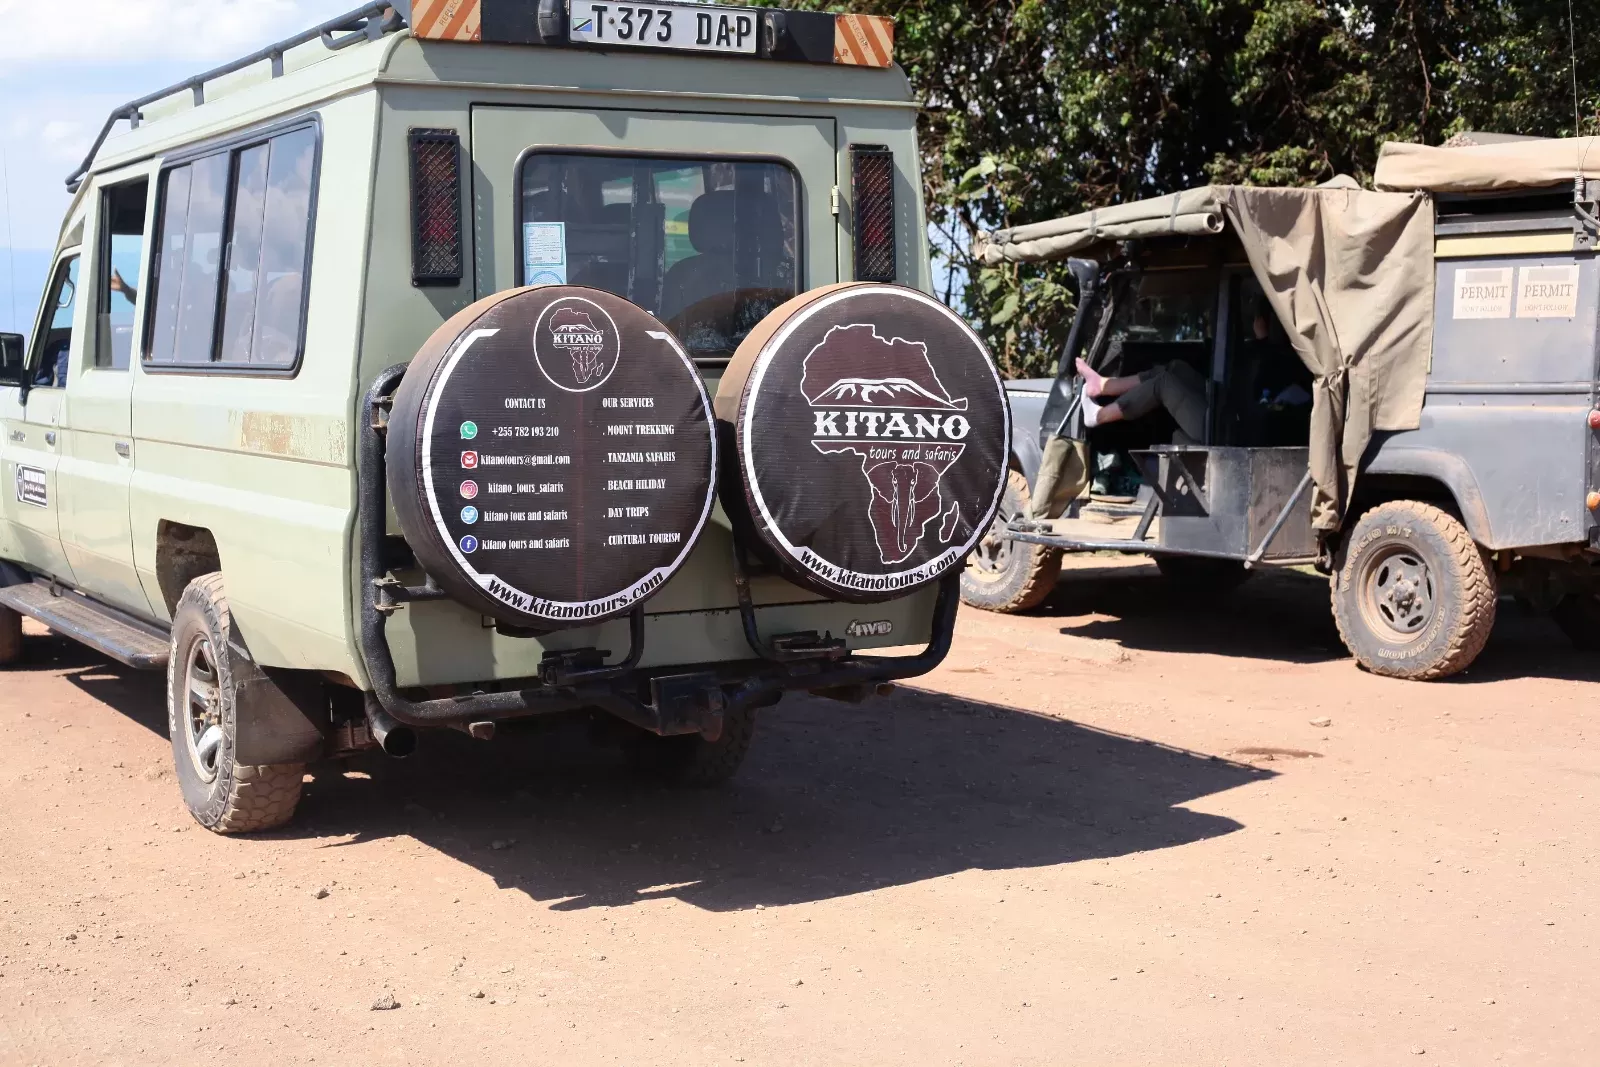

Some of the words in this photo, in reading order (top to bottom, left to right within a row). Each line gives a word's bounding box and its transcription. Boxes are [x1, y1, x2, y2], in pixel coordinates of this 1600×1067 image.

[591, 5, 607, 37] T
[617, 7, 672, 42] 373
[696, 13, 751, 47] DAP
[1460, 285, 1508, 299] PERMIT
[1524, 284, 1573, 298] PERMIT
[553, 334, 603, 344] KITANO
[505, 398, 536, 409] CONTACT
[538, 398, 546, 409] US
[602, 397, 618, 408] OUR
[620, 397, 655, 408] SERVICES
[491, 426, 513, 437] +255
[515, 426, 530, 437] 782
[531, 426, 544, 437] 193
[546, 426, 559, 437] 210
[607, 425, 633, 436] MOUNT
[635, 424, 675, 435] TREKKING
[813, 411, 971, 440] KITANO
[608, 452, 644, 463] TANZANIA
[645, 451, 676, 463] SAFARIS
[869, 445, 897, 460] tours
[901, 444, 921, 460] and
[924, 445, 957, 461] safaris
[480, 454, 571, 467] kitanotours@gmail.com
[488, 481, 564, 494] kitano_tours_safaris
[608, 480, 633, 491] BEACH
[484, 511, 508, 522] kitano
[527, 510, 542, 521] and
[543, 509, 568, 520] safaris
[608, 507, 623, 518] DAY
[626, 506, 649, 518] TRIPS
[482, 539, 506, 550] kitano
[508, 539, 527, 550] tours
[529, 538, 543, 549] and
[544, 537, 570, 549] safaris
[649, 532, 681, 544] TOURISM
[800, 550, 958, 590] www.kitanotours.com
[488, 571, 664, 618] www.kitanotours.com
